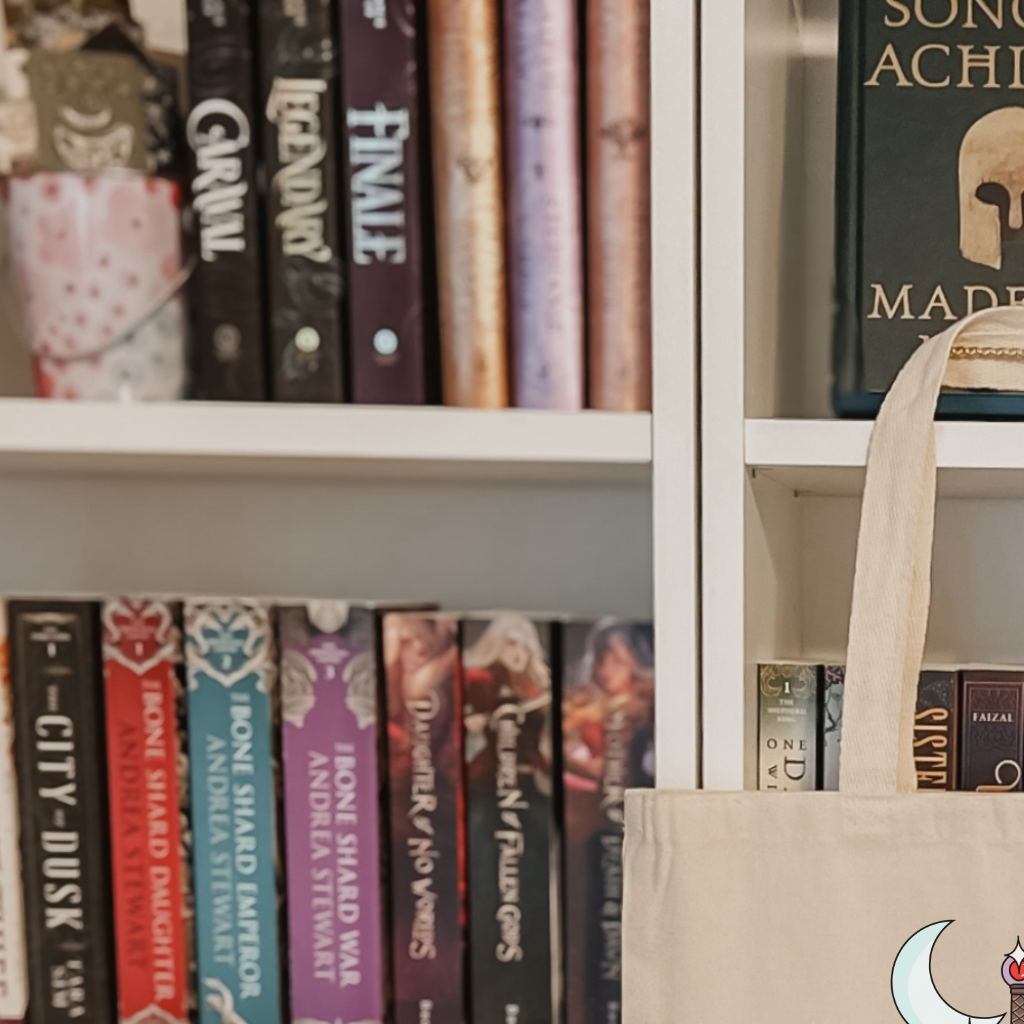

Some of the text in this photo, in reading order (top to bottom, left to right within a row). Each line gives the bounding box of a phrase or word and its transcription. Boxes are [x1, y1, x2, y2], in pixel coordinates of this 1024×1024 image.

[347, 102, 410, 266] FINALE
[142, 690, 168, 762] BONE
[230, 704, 257, 775] BONE
[767, 738, 807, 750] ONE
[914, 707, 949, 791] SISTE
[972, 712, 1014, 722] FAIZAL
[35, 714, 84, 931] CITY DUSK
[145, 768, 170, 860] SHARD
[234, 782, 259, 875] SHARD
[333, 755, 359, 826] BONE
[205, 734, 235, 969] ANDREA STEWART
[307, 750, 336, 984] ANDREA STEWART
[335, 832, 360, 924] SHARD
[150, 865, 175, 1002] DAUGHTER
[238, 882, 262, 1000] EMPEROR
[338, 930, 362, 989] WAR
